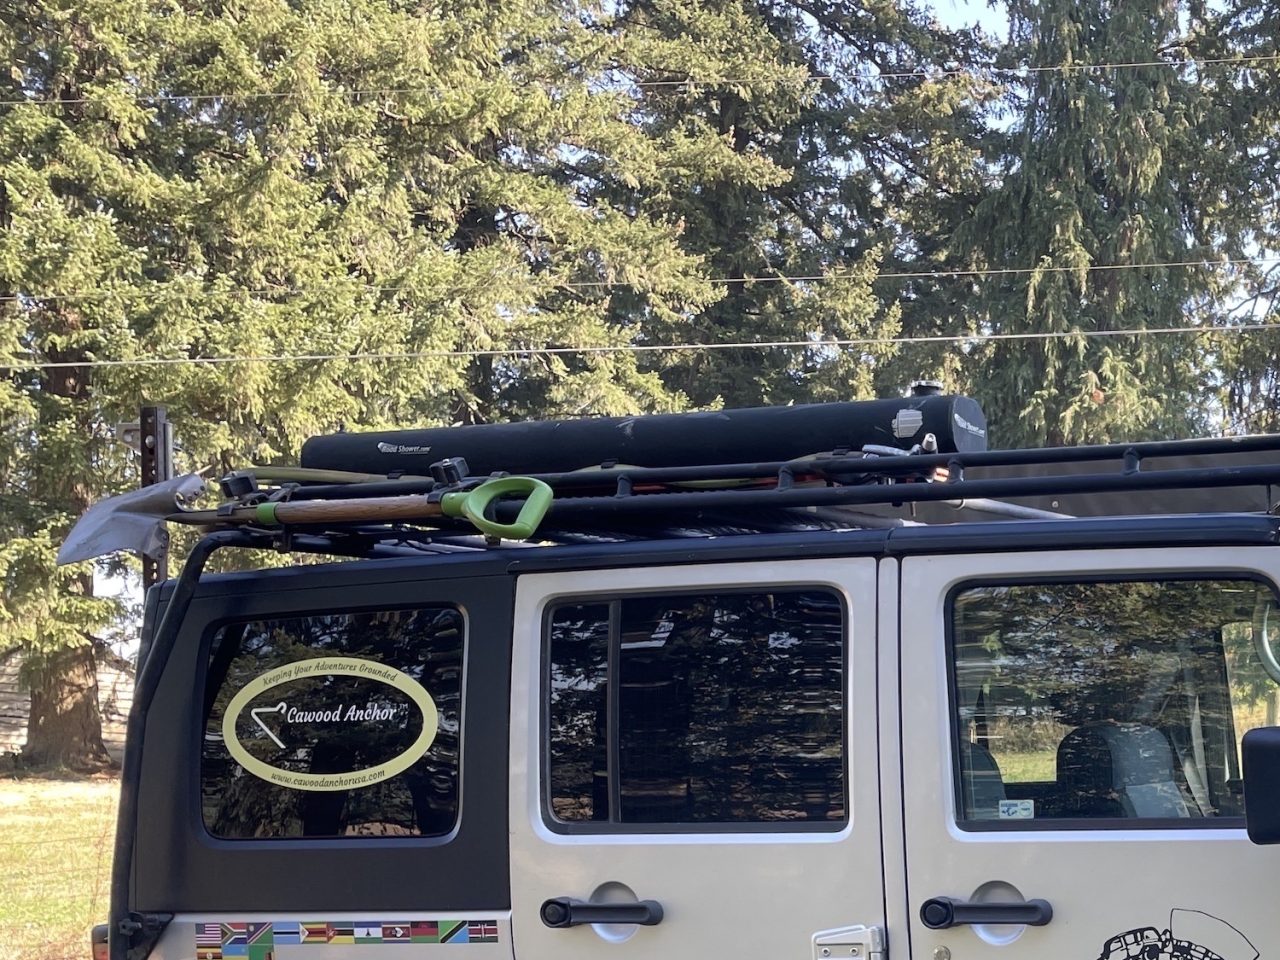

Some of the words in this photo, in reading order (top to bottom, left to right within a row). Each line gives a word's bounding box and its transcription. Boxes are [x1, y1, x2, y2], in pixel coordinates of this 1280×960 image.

[263, 669, 292, 687] Keeping
[294, 664, 312, 677] Your
[314, 661, 357, 672] Adventures
[359, 664, 398, 682] Grounded
[287, 703, 342, 723] Cawood
[343, 704, 398, 722] Anchor
[271, 769, 385, 788] www.cawoodanchorusa.com
